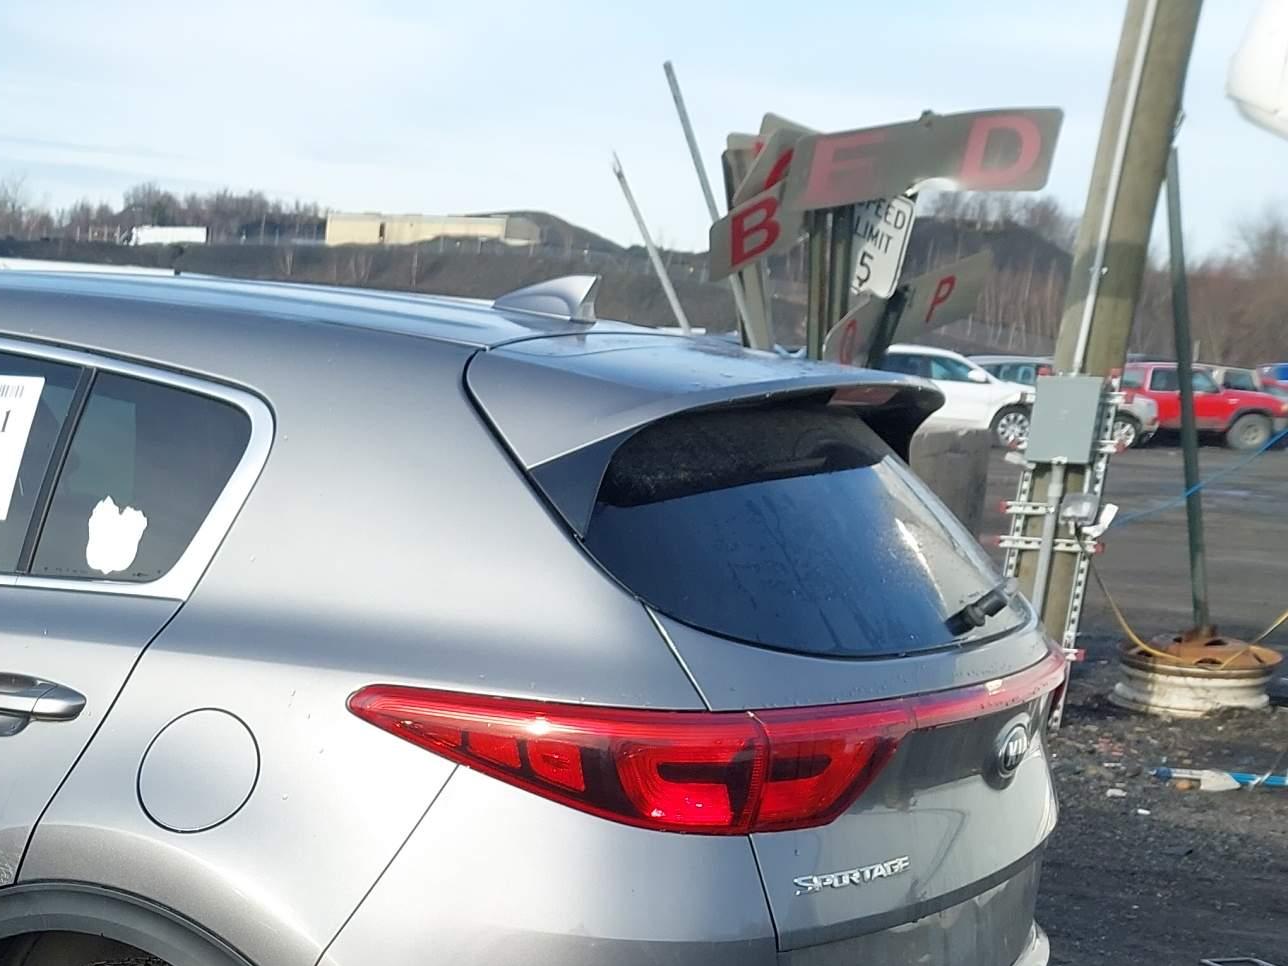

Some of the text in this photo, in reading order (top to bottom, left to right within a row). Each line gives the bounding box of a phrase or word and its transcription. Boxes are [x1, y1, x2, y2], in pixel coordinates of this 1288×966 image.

[960, 115, 1041, 186] D
[730, 197, 781, 268] B
[853, 216, 894, 254] LIMIT
[925, 274, 957, 324] P
[793, 855, 911, 896] SPORTAGE
